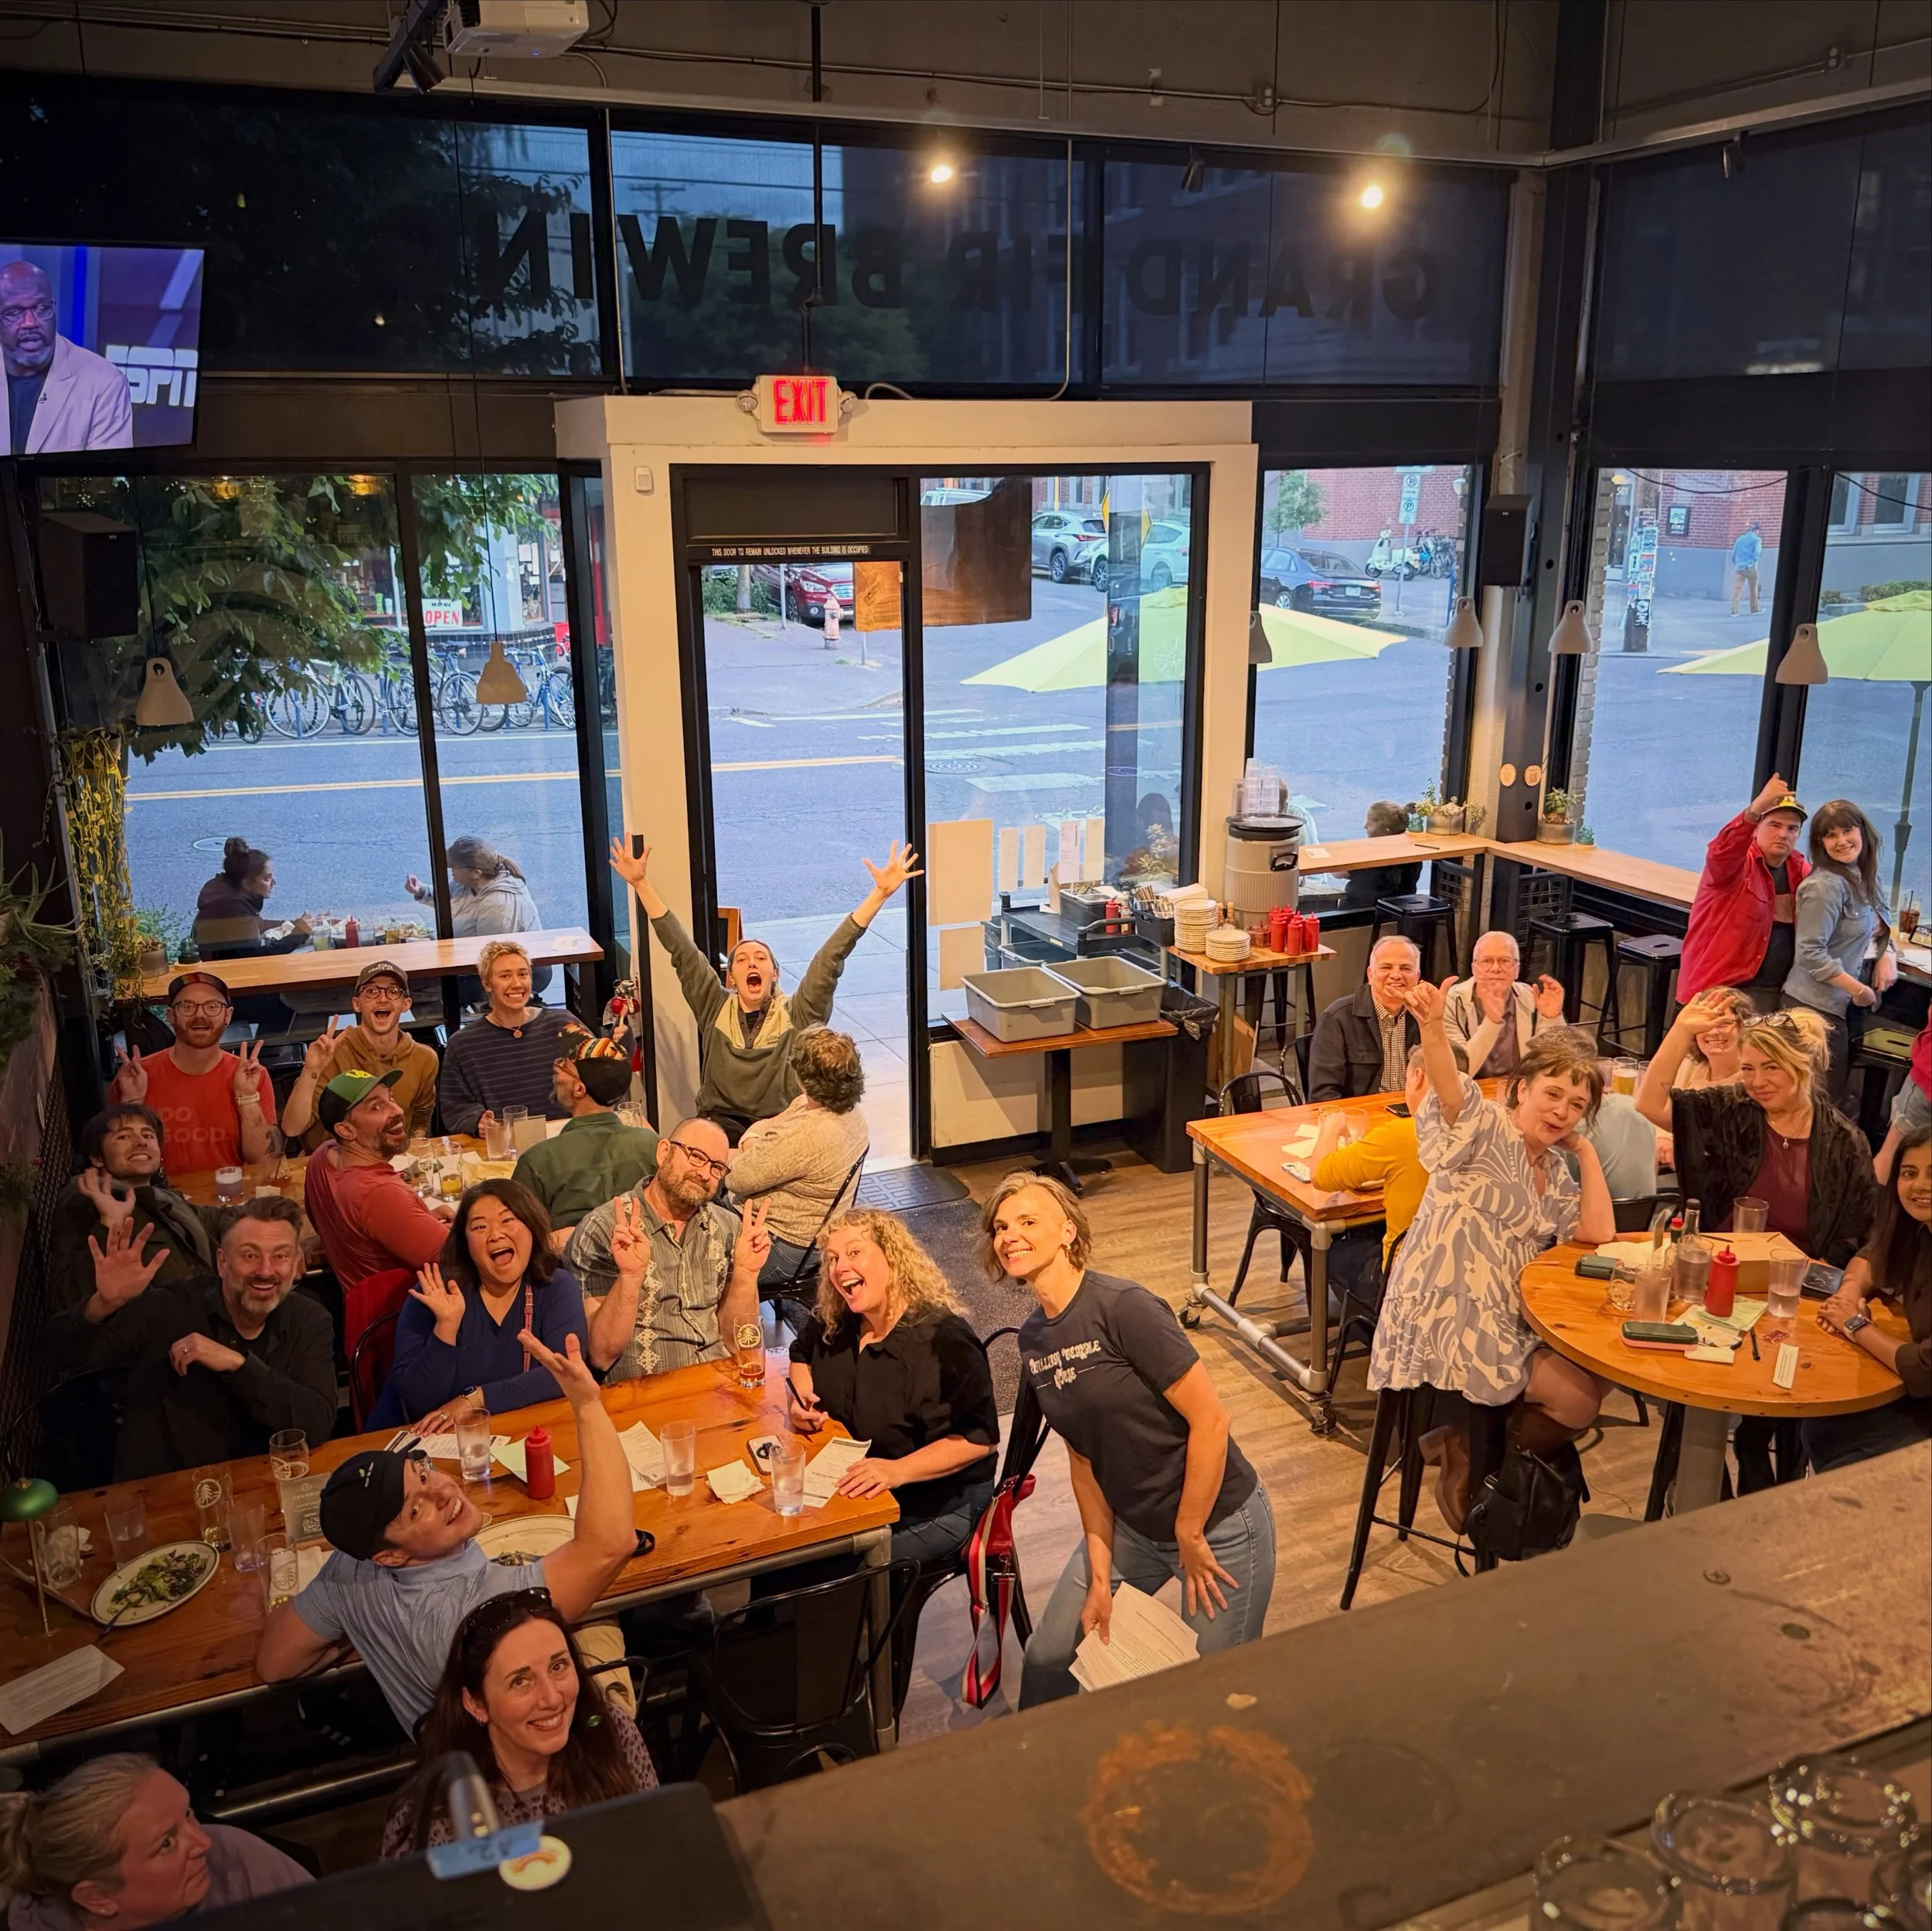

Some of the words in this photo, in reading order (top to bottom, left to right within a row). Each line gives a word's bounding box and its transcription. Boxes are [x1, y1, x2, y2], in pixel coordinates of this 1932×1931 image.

[774, 379, 828, 425] EXIT
[712, 548, 723, 556] THIS
[723, 548, 736, 556] DOOR
[745, 547, 762, 556] REMAIN
[763, 547, 786, 556] UNLOCKED
[787, 546, 811, 555] WHENEVER
[811, 546, 820, 555] THE
[821, 546, 841, 554] BUILDING
[842, 546, 847, 554] IS
[848, 545, 869, 553] OCCUPIED
[425, 610, 460, 625] OPEN
[158, 1106, 192, 1123] DO
